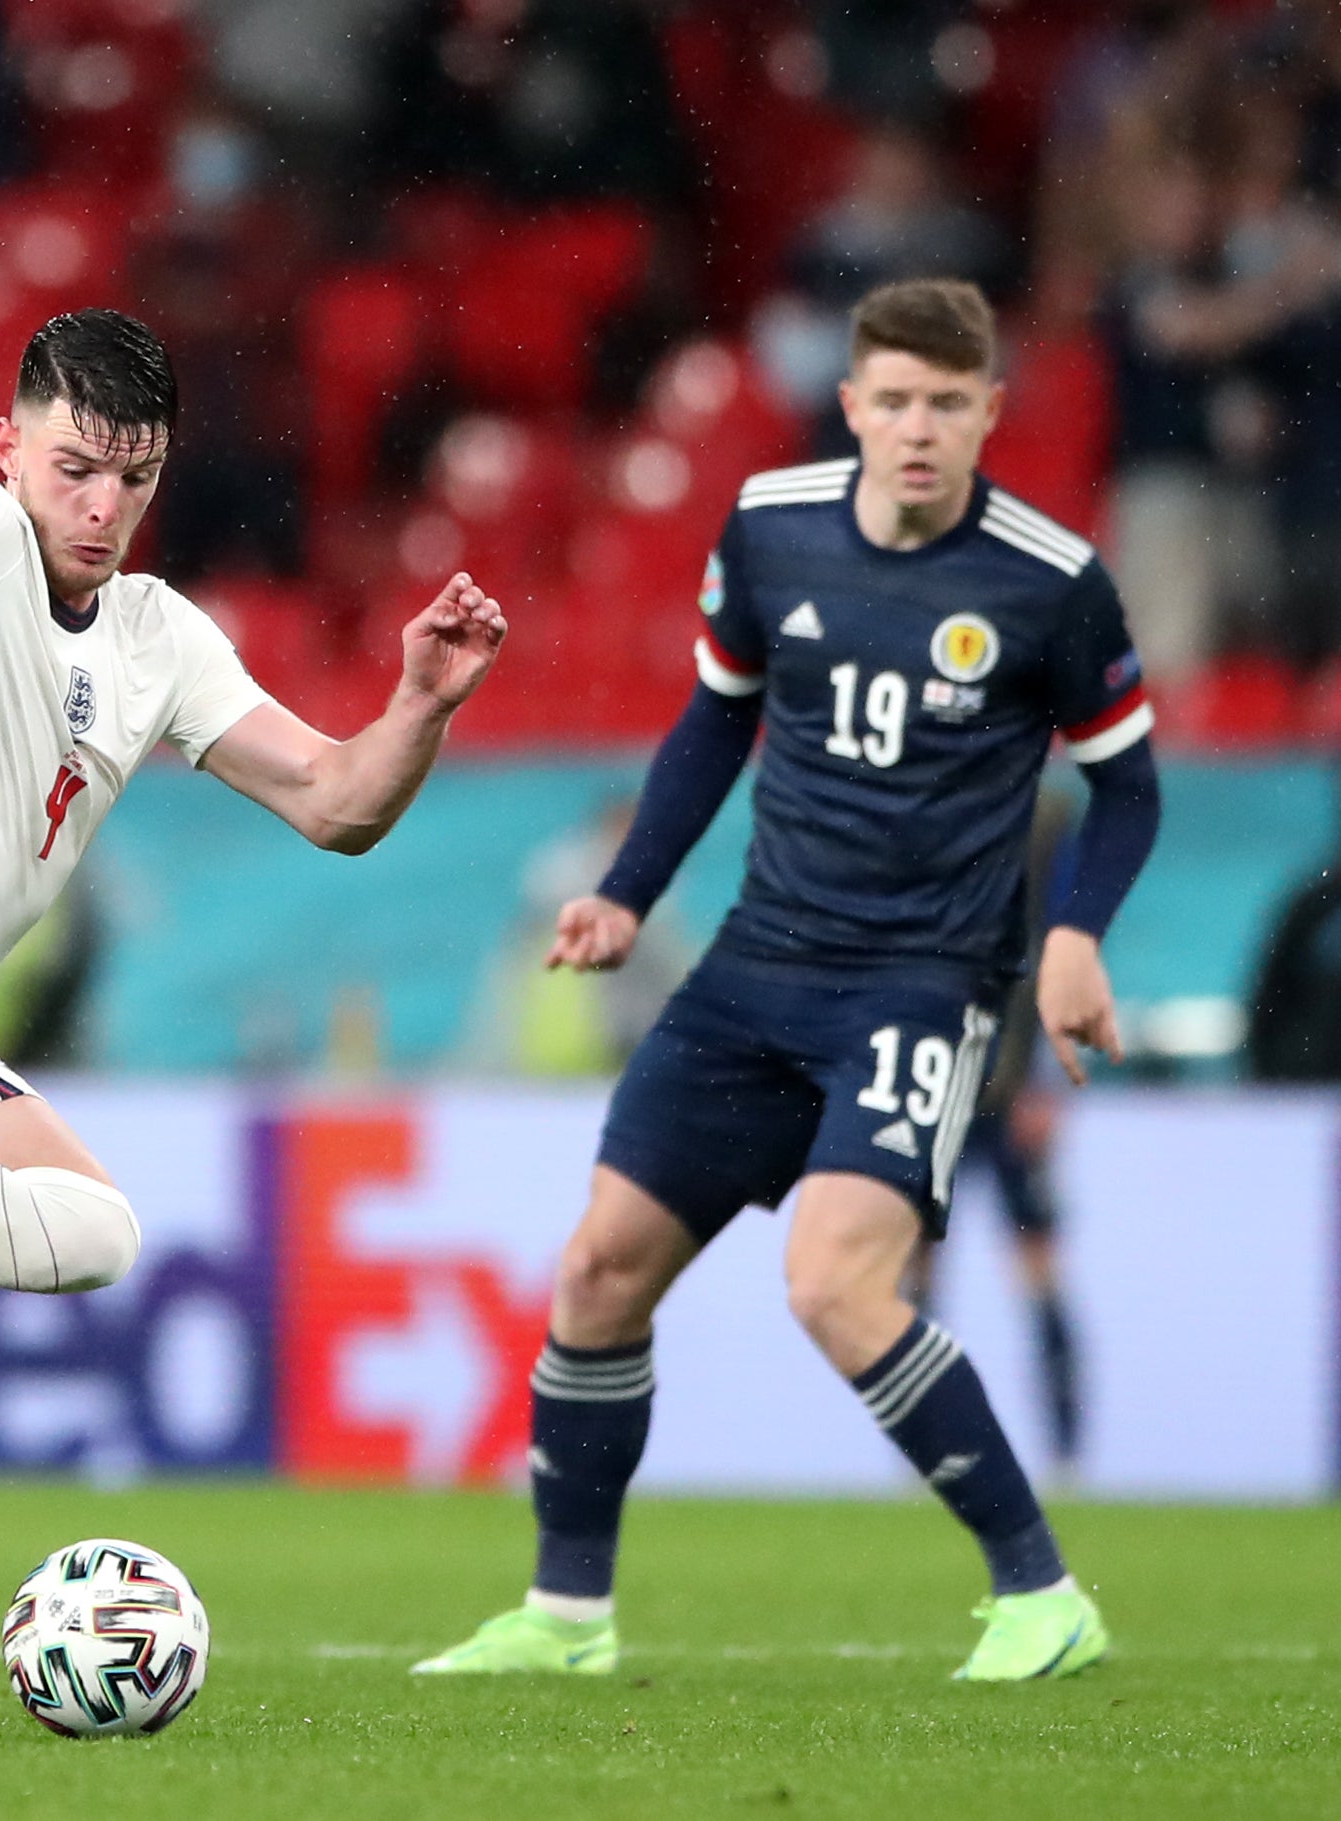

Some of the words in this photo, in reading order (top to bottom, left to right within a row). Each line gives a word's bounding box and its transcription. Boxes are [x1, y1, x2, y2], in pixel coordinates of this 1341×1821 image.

[825, 662, 909, 768] 19
[37, 764, 88, 861] 4
[856, 1026, 953, 1127] 19
